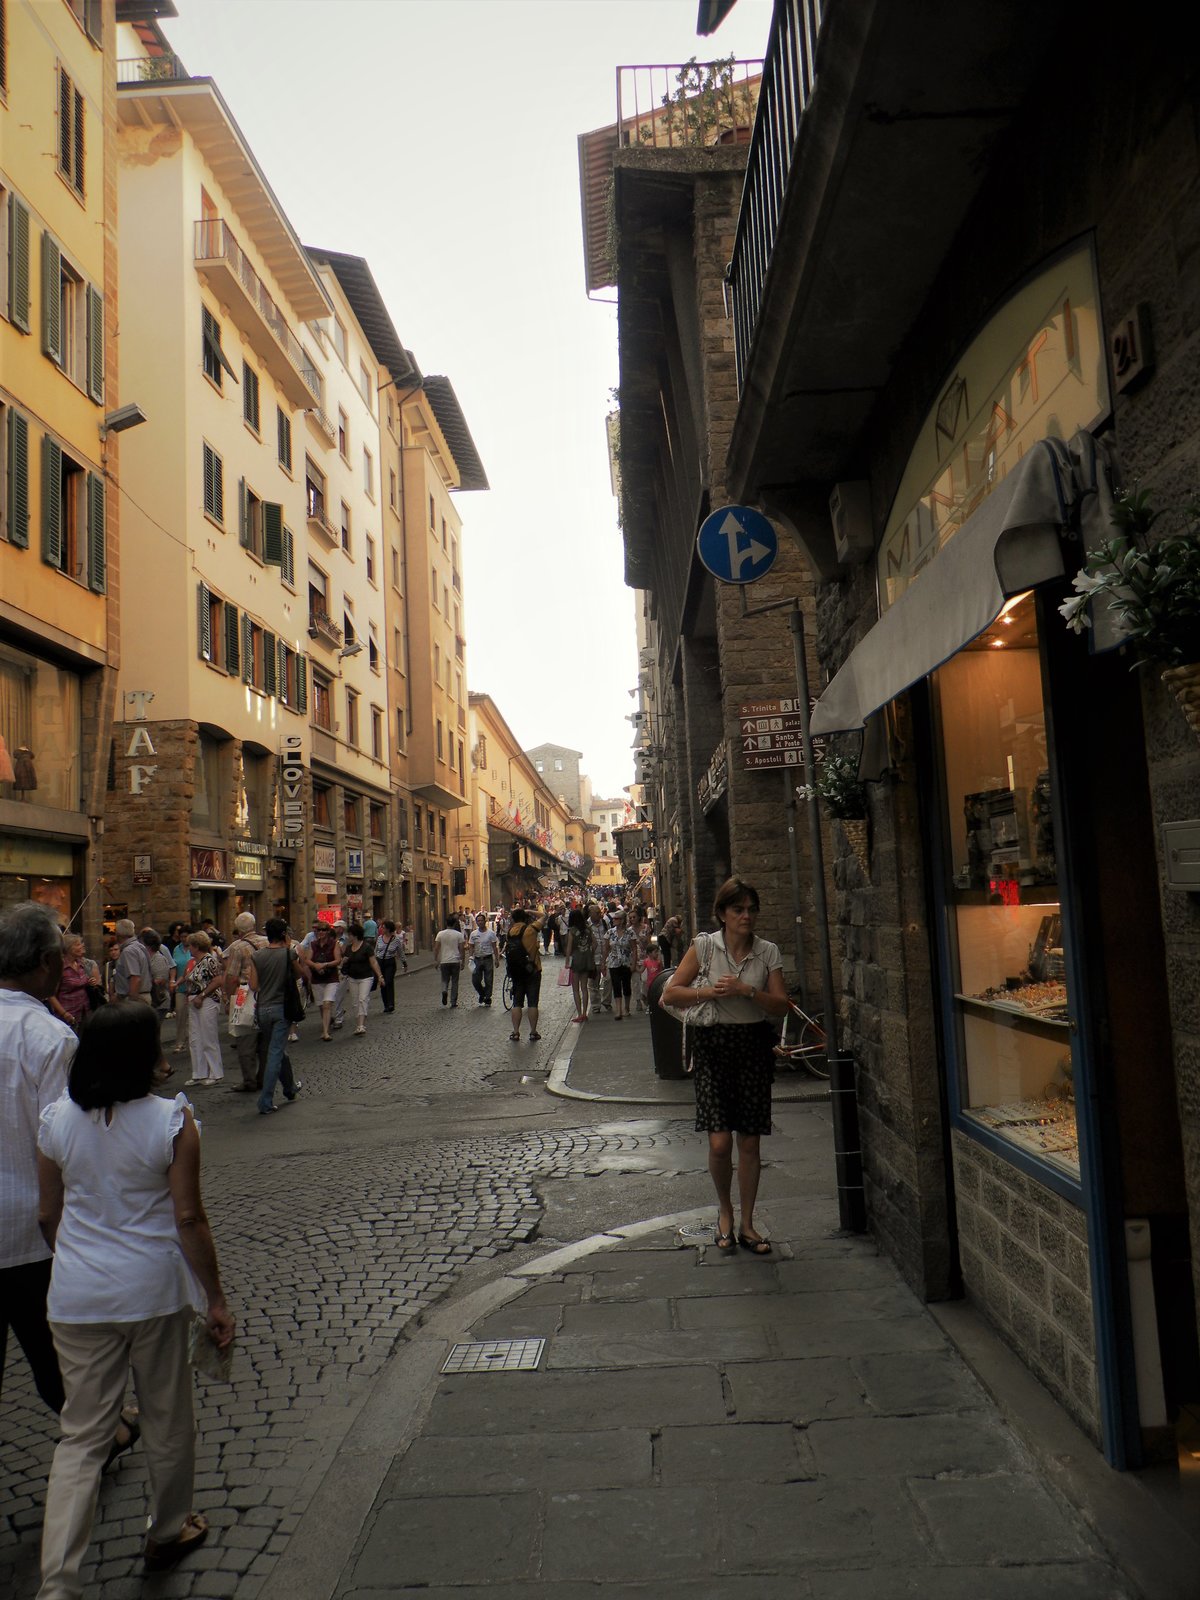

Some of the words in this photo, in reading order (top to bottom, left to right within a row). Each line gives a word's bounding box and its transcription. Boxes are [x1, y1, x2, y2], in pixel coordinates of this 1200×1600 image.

[742, 706, 750, 714] S.
[751, 704, 777, 713] Trinita
[124, 690, 158, 796] TAF
[775, 734, 795, 742] Santo
[784, 740, 800, 748] Ponte
[754, 755, 782, 765] Apostoli
[282, 735, 304, 833] GLOVES
[276, 838, 304, 848] TIES
[635, 847, 659, 860] UGO
